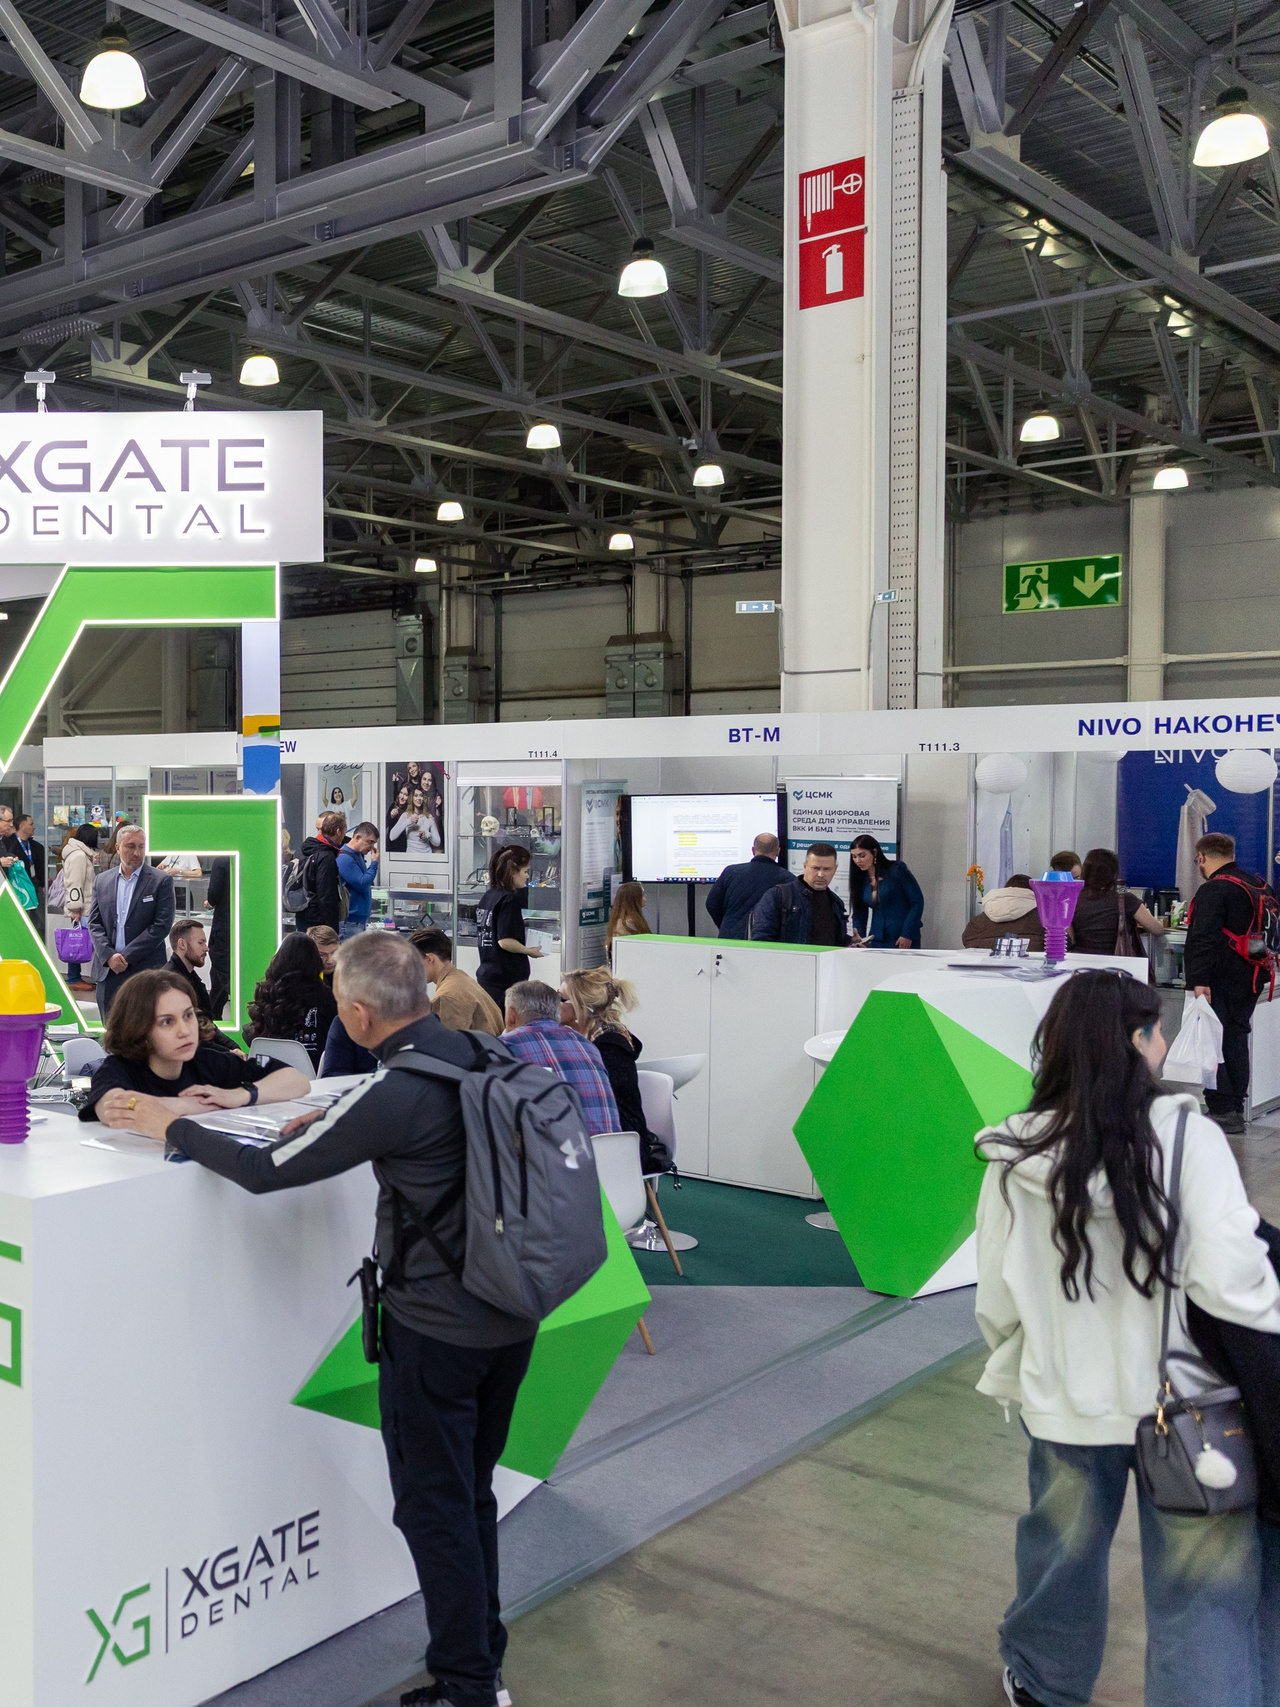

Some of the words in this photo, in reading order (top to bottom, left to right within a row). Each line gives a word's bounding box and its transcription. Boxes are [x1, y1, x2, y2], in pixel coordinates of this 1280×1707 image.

[1078, 717, 1142, 736] NIVO
[919, 742, 960, 752] T111.3
[528, 750, 558, 759] T111.4
[805, 791, 833, 799] ЦСМК
[837, 818, 890, 826] УПРАВЛЕНИЯ
[181, 1509, 320, 1608] XGATE
[84, 1582, 151, 1685] XG
[181, 1558, 320, 1639] DENTAL
